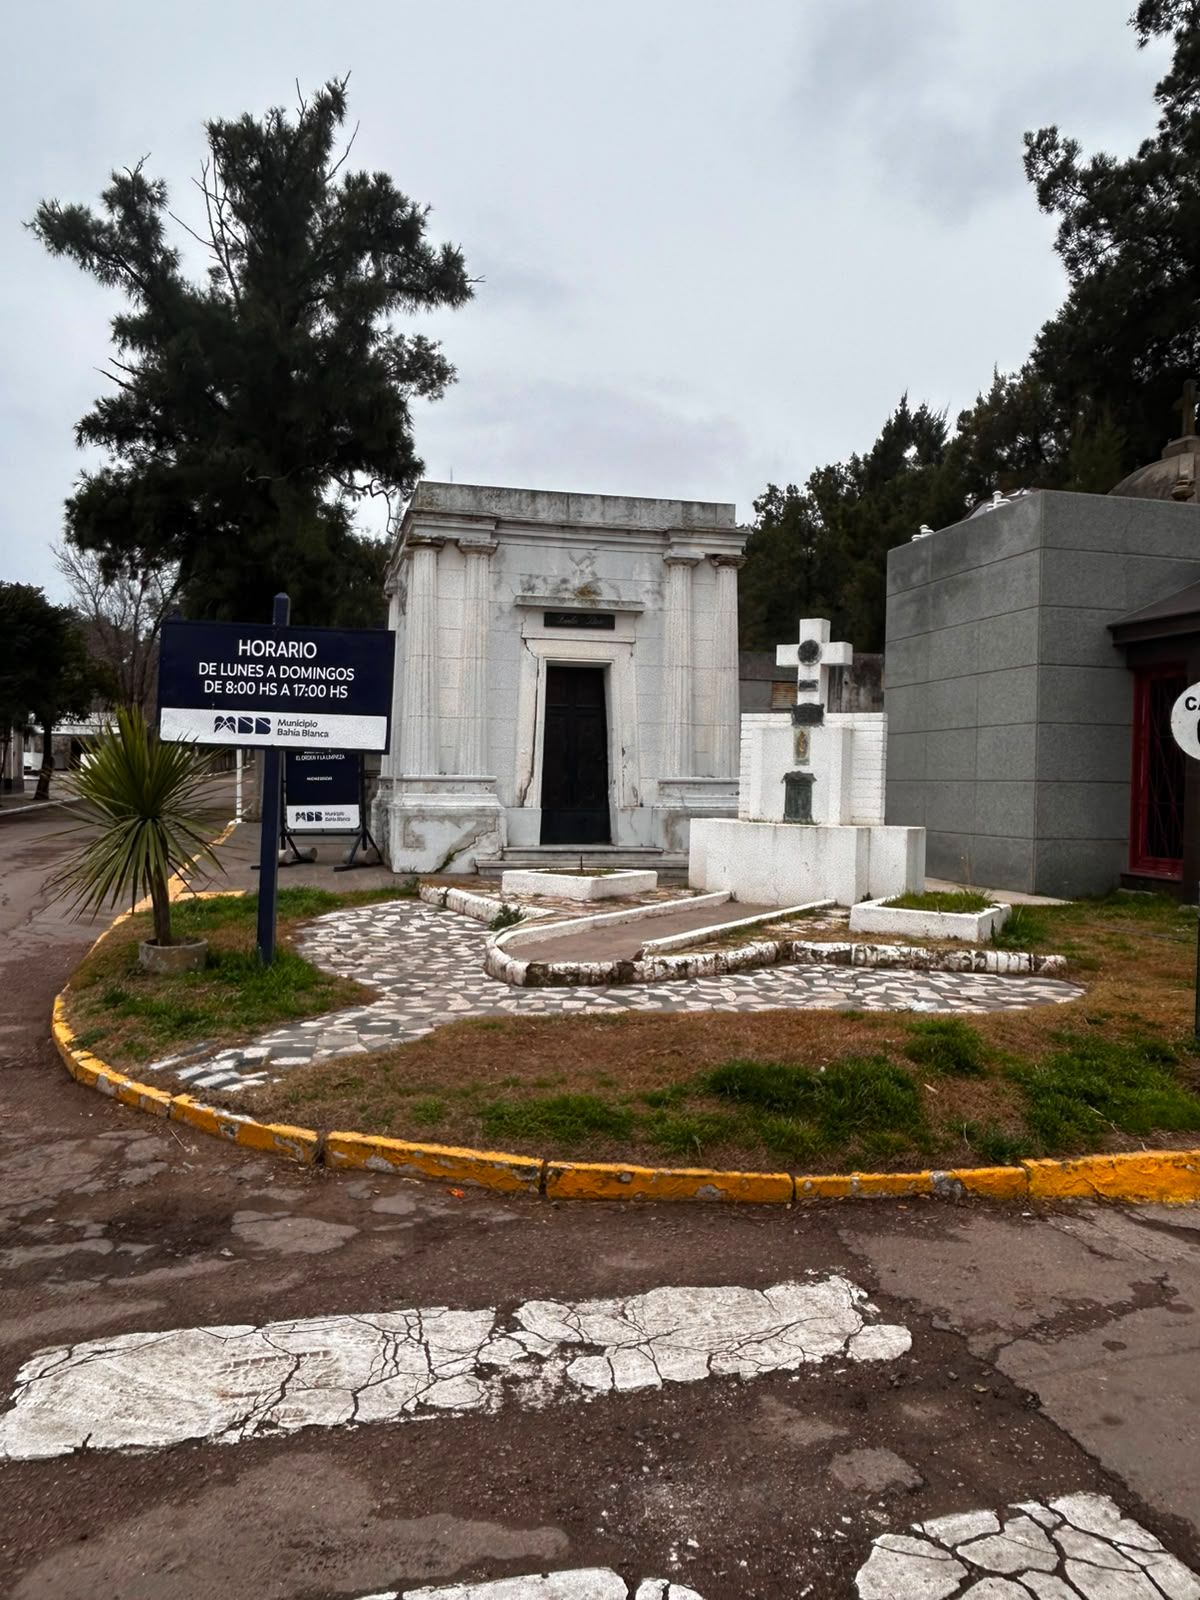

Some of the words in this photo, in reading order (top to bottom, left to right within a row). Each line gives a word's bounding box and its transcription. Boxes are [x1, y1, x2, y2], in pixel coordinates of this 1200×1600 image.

[238, 639, 318, 659] HORARIO
[198, 662, 217, 676] DE
[220, 663, 264, 677] LUNES
[266, 665, 277, 678] A
[279, 665, 355, 681] DOMINGOS
[204, 680, 223, 693] DE
[225, 681, 256, 695] 8:00
[259, 682, 278, 696] HS
[280, 683, 291, 696] A
[293, 683, 327, 697] 17:00
[330, 685, 348, 698] HS
[1185, 696, 1200, 711] C
[277, 719, 318, 729] Municipio
[302, 729, 329, 738] Blanca
